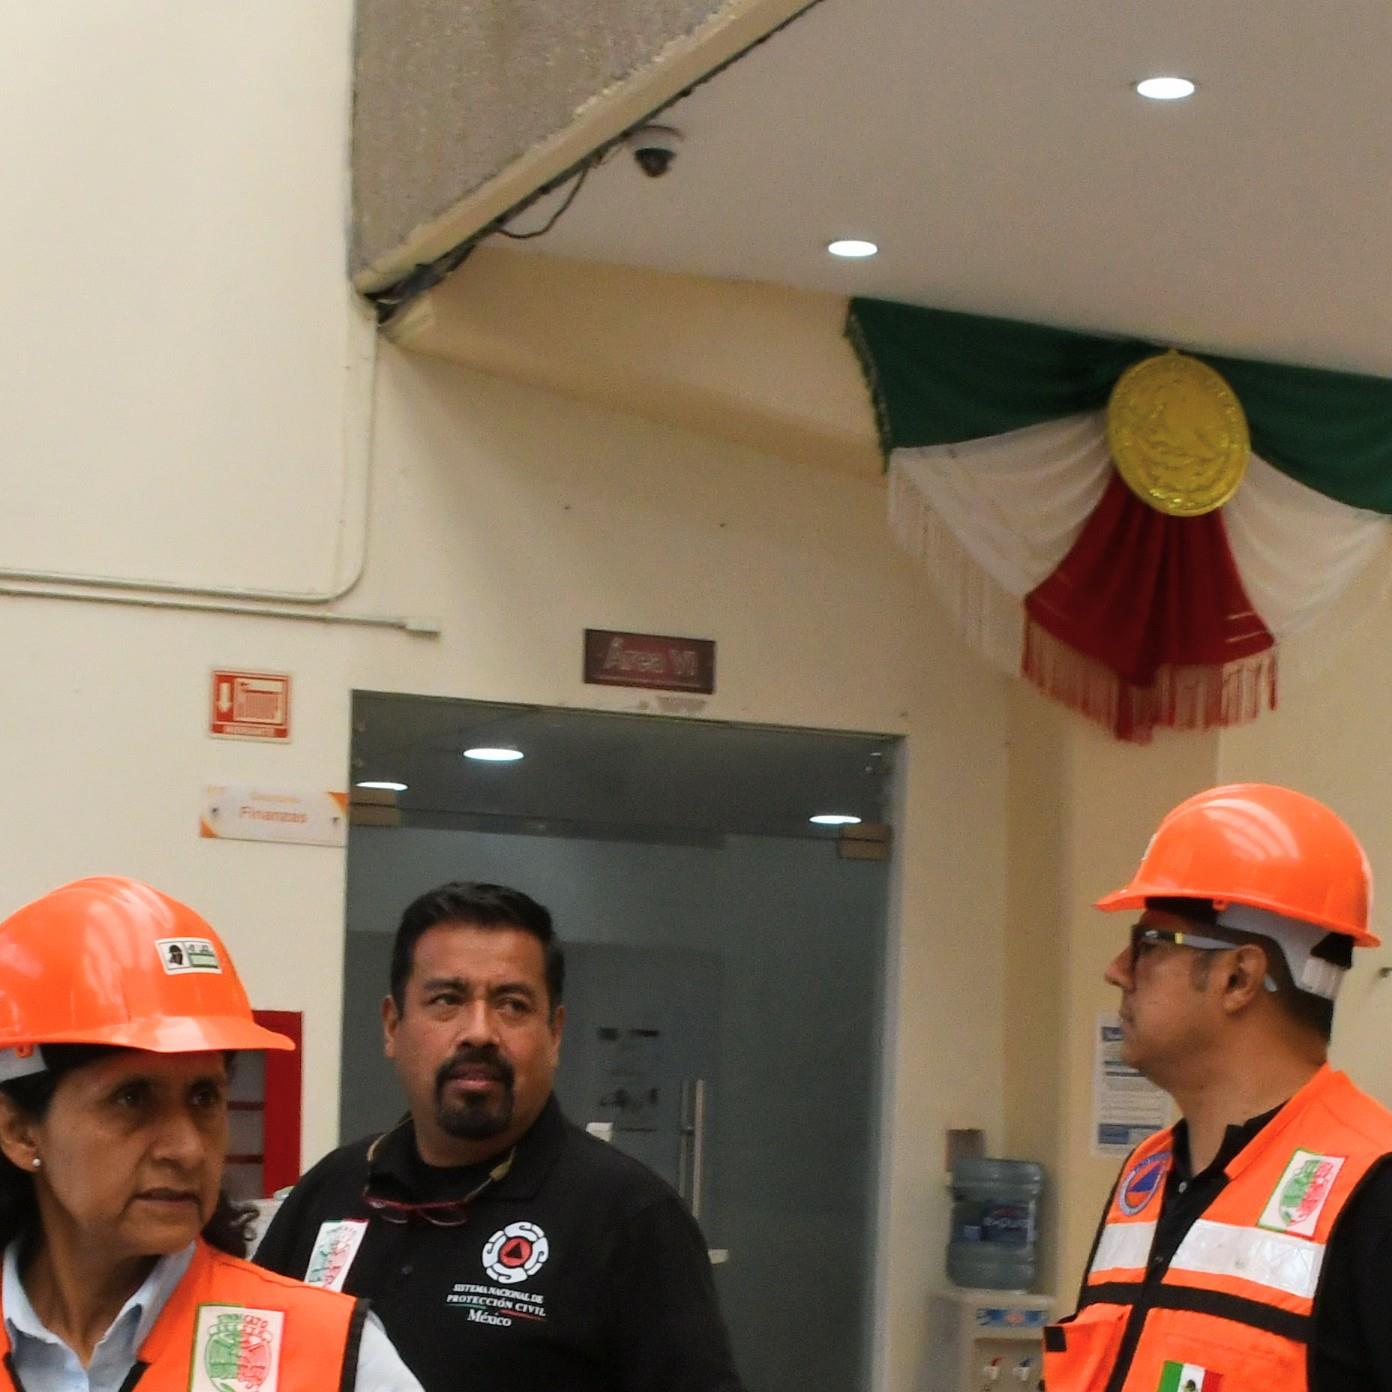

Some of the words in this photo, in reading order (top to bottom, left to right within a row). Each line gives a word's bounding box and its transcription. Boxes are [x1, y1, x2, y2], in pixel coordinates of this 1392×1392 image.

[453, 1283, 487, 1294] SISTEMA
[488, 1287, 530, 1302] NACIONAL
[531, 1293, 544, 1304] DE
[446, 1294, 513, 1309] PROTECCIÓN
[515, 1302, 546, 1317] CIVIL
[467, 1308, 512, 1327] México
